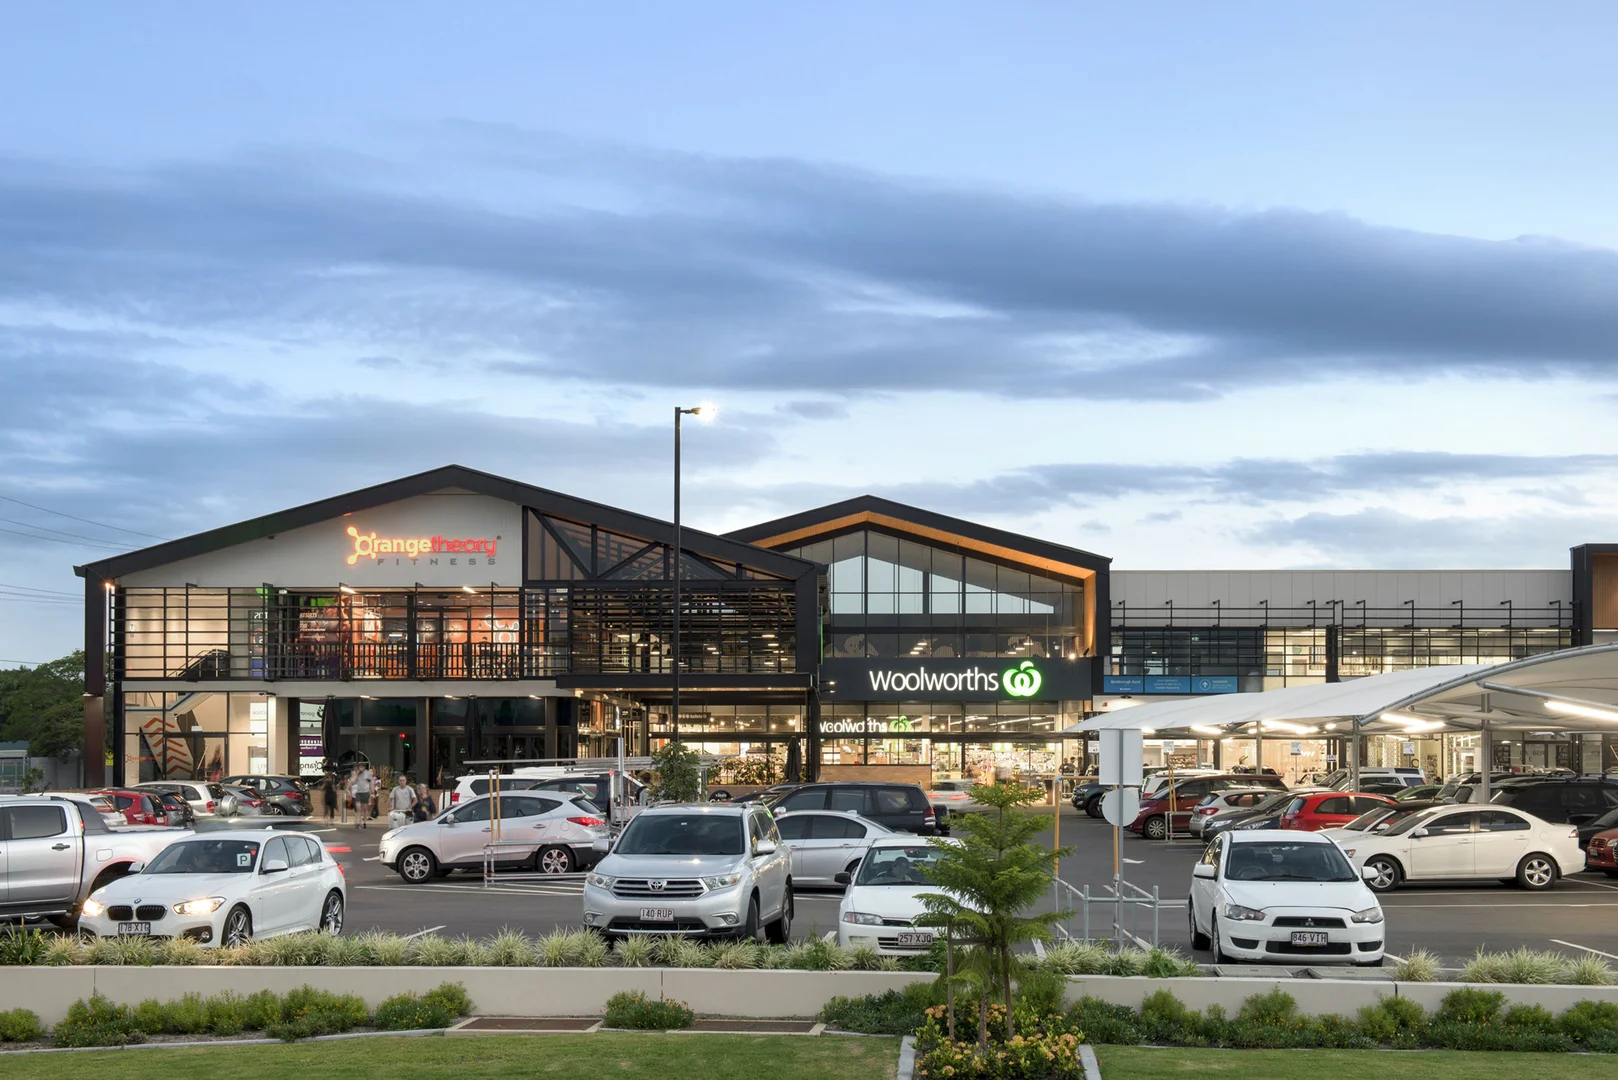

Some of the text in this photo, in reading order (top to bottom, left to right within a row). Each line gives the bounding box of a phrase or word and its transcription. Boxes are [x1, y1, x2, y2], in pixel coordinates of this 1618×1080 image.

[377, 558, 496, 566] FITNESS
[869, 666, 999, 691] Woolworths
[239, 854, 248, 865] P
[657, 909, 673, 918] RUP
[899, 934, 913, 943] 257
